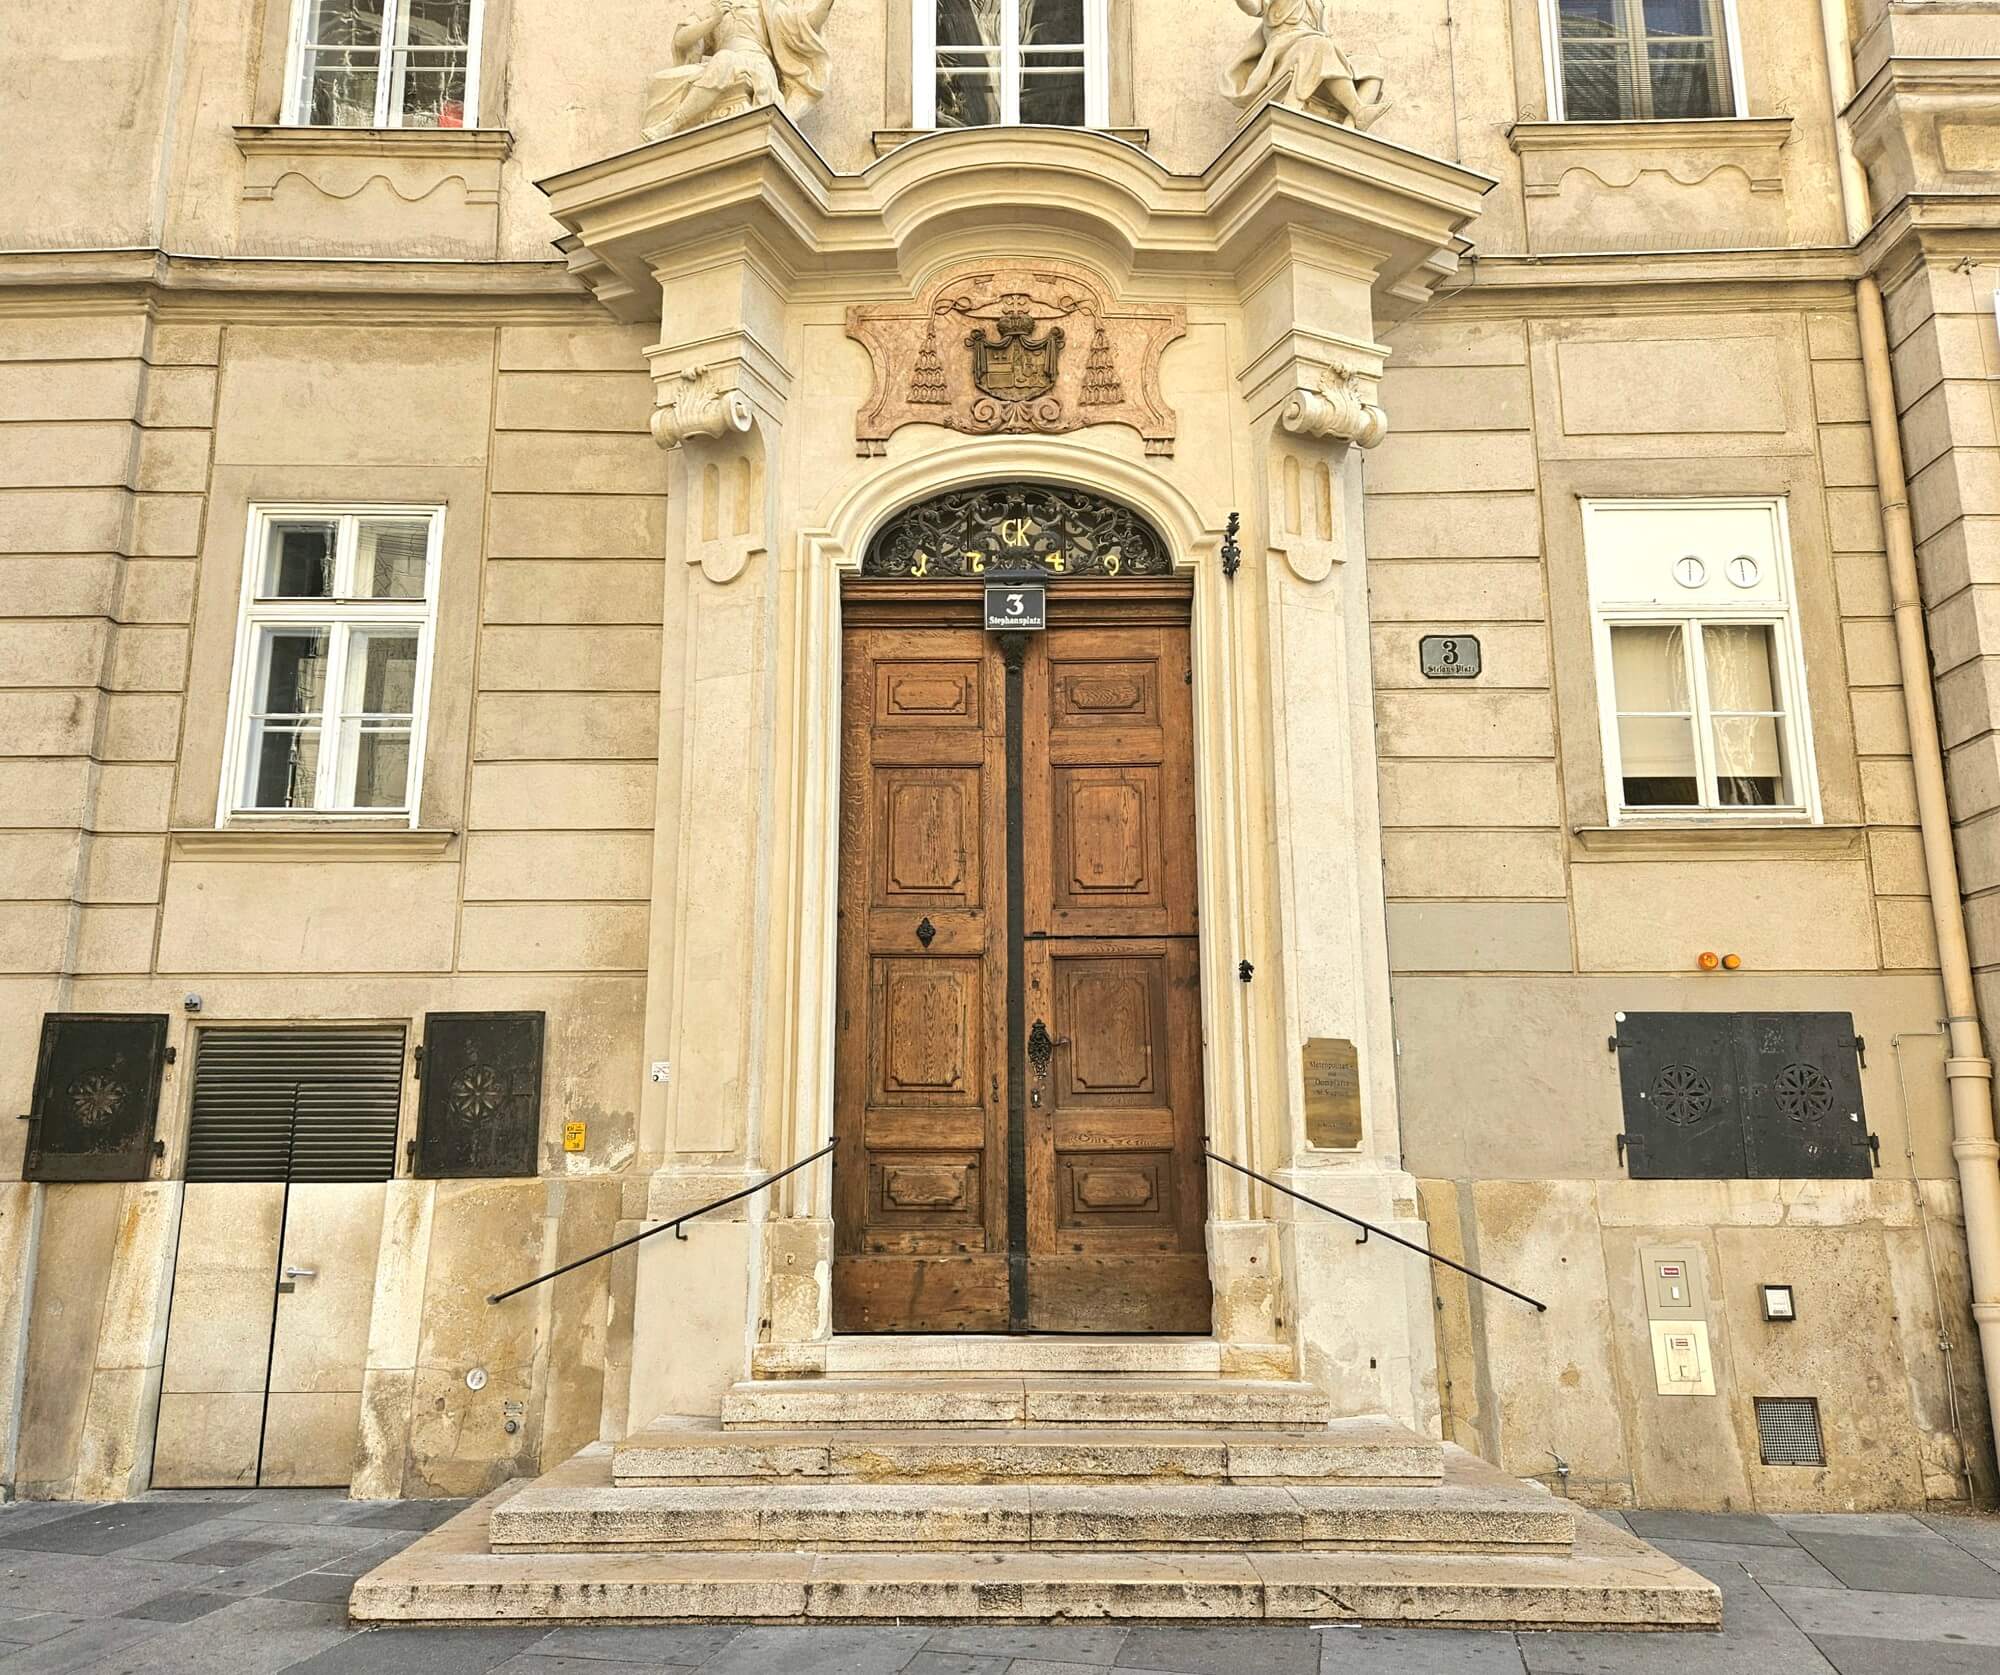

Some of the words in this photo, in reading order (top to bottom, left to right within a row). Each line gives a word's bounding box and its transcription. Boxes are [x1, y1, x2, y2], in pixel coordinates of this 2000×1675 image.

[1006, 594, 1024, 615] 3
[989, 616, 1041, 626] Stephansplatz
[1443, 640, 1458, 664] 3
